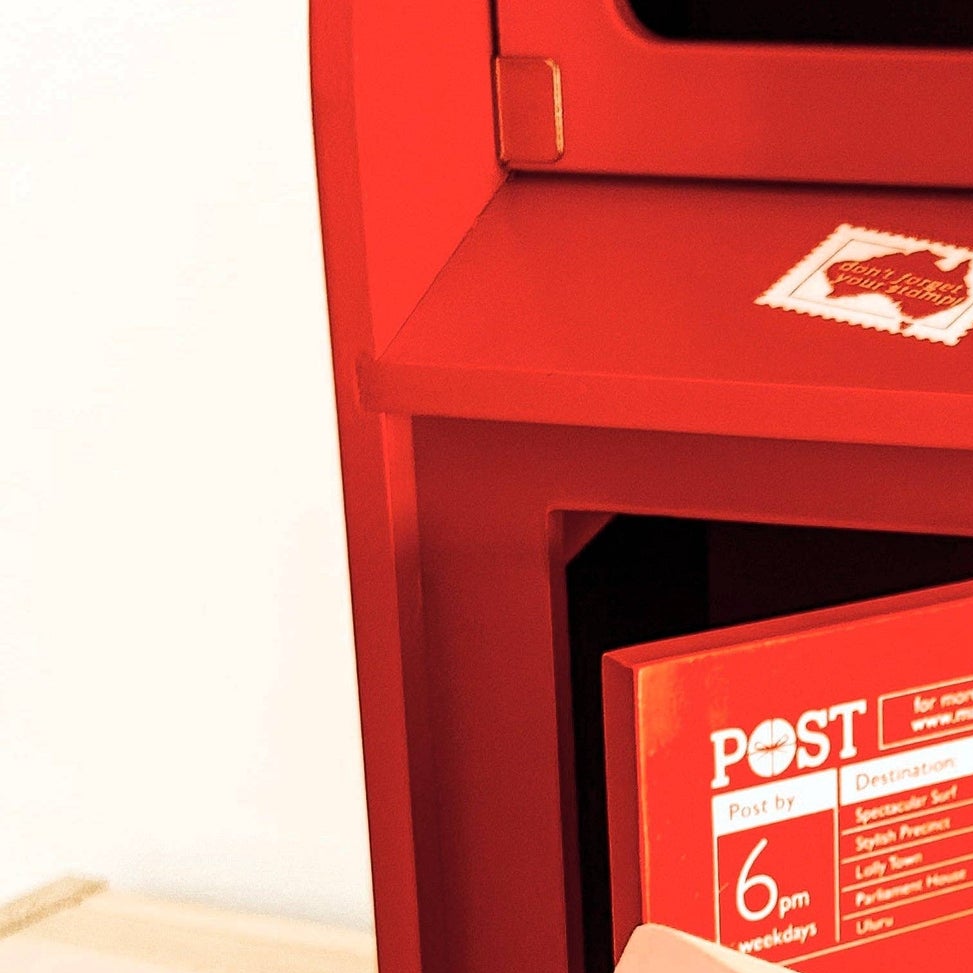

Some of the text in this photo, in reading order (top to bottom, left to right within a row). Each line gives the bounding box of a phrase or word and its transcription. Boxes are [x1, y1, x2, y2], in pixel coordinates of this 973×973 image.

[832, 273, 886, 291] your
[839, 261, 964, 294] don't forget
[913, 695, 937, 714] for
[710, 699, 868, 789] POST
[855, 756, 956, 791] Destination
[728, 794, 796, 822] Post by
[855, 784, 958, 825] Spectacular Surf
[855, 817, 951, 852] Stylish Precinct
[855, 860, 888, 880] Lolly
[739, 921, 819, 954] weekdays
[855, 917, 895, 935] Uluru
